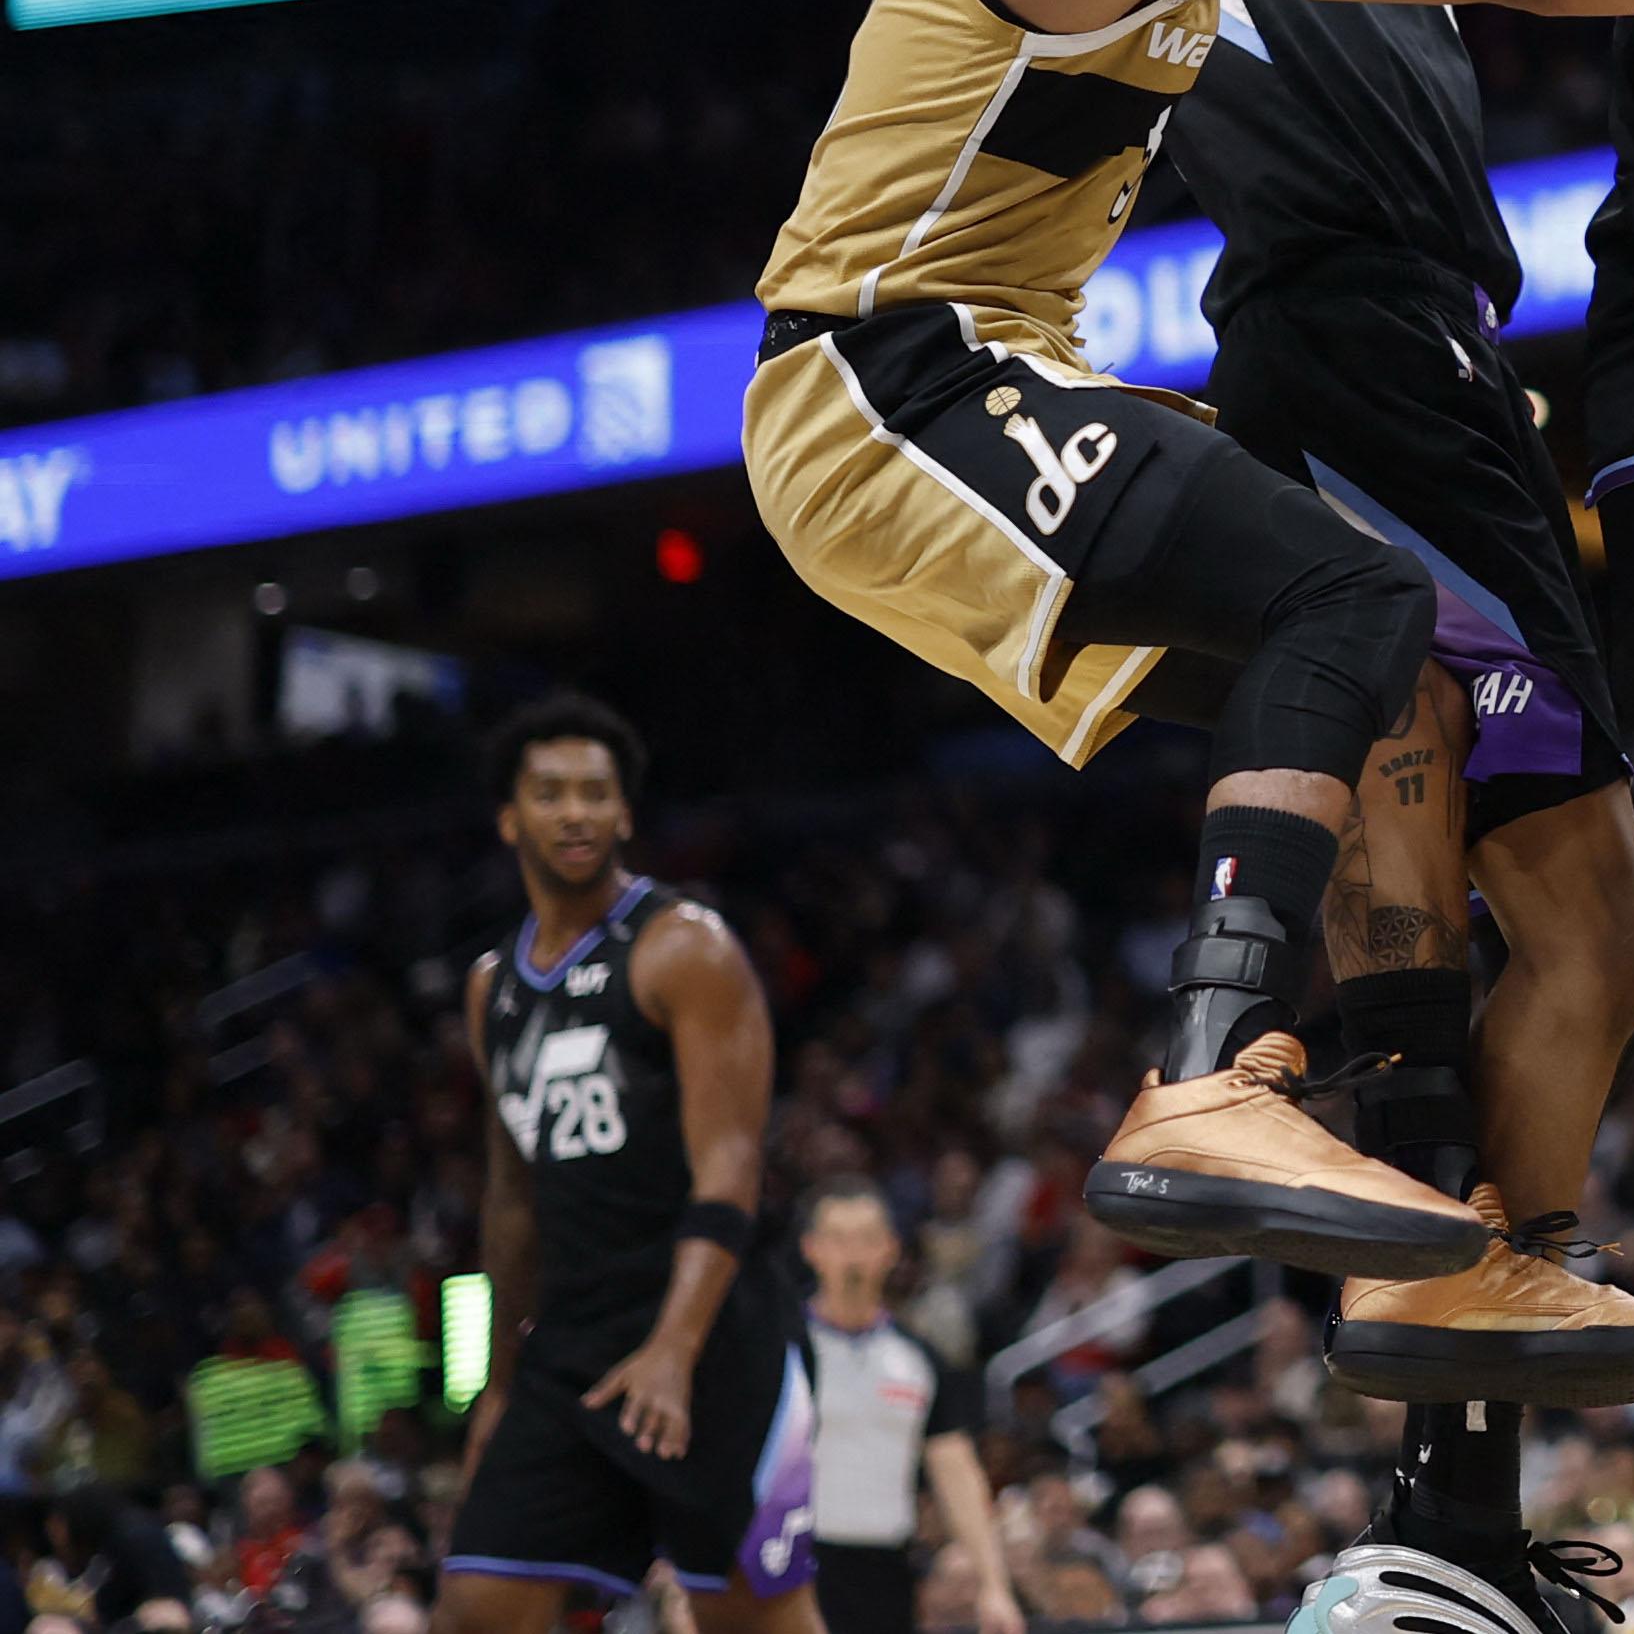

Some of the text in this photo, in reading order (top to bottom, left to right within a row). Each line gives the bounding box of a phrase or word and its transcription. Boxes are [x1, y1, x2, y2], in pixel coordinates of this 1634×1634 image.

[270, 378, 572, 494] UNITED
[1395, 772, 1425, 806] 11
[546, 1073, 627, 1162] 28
